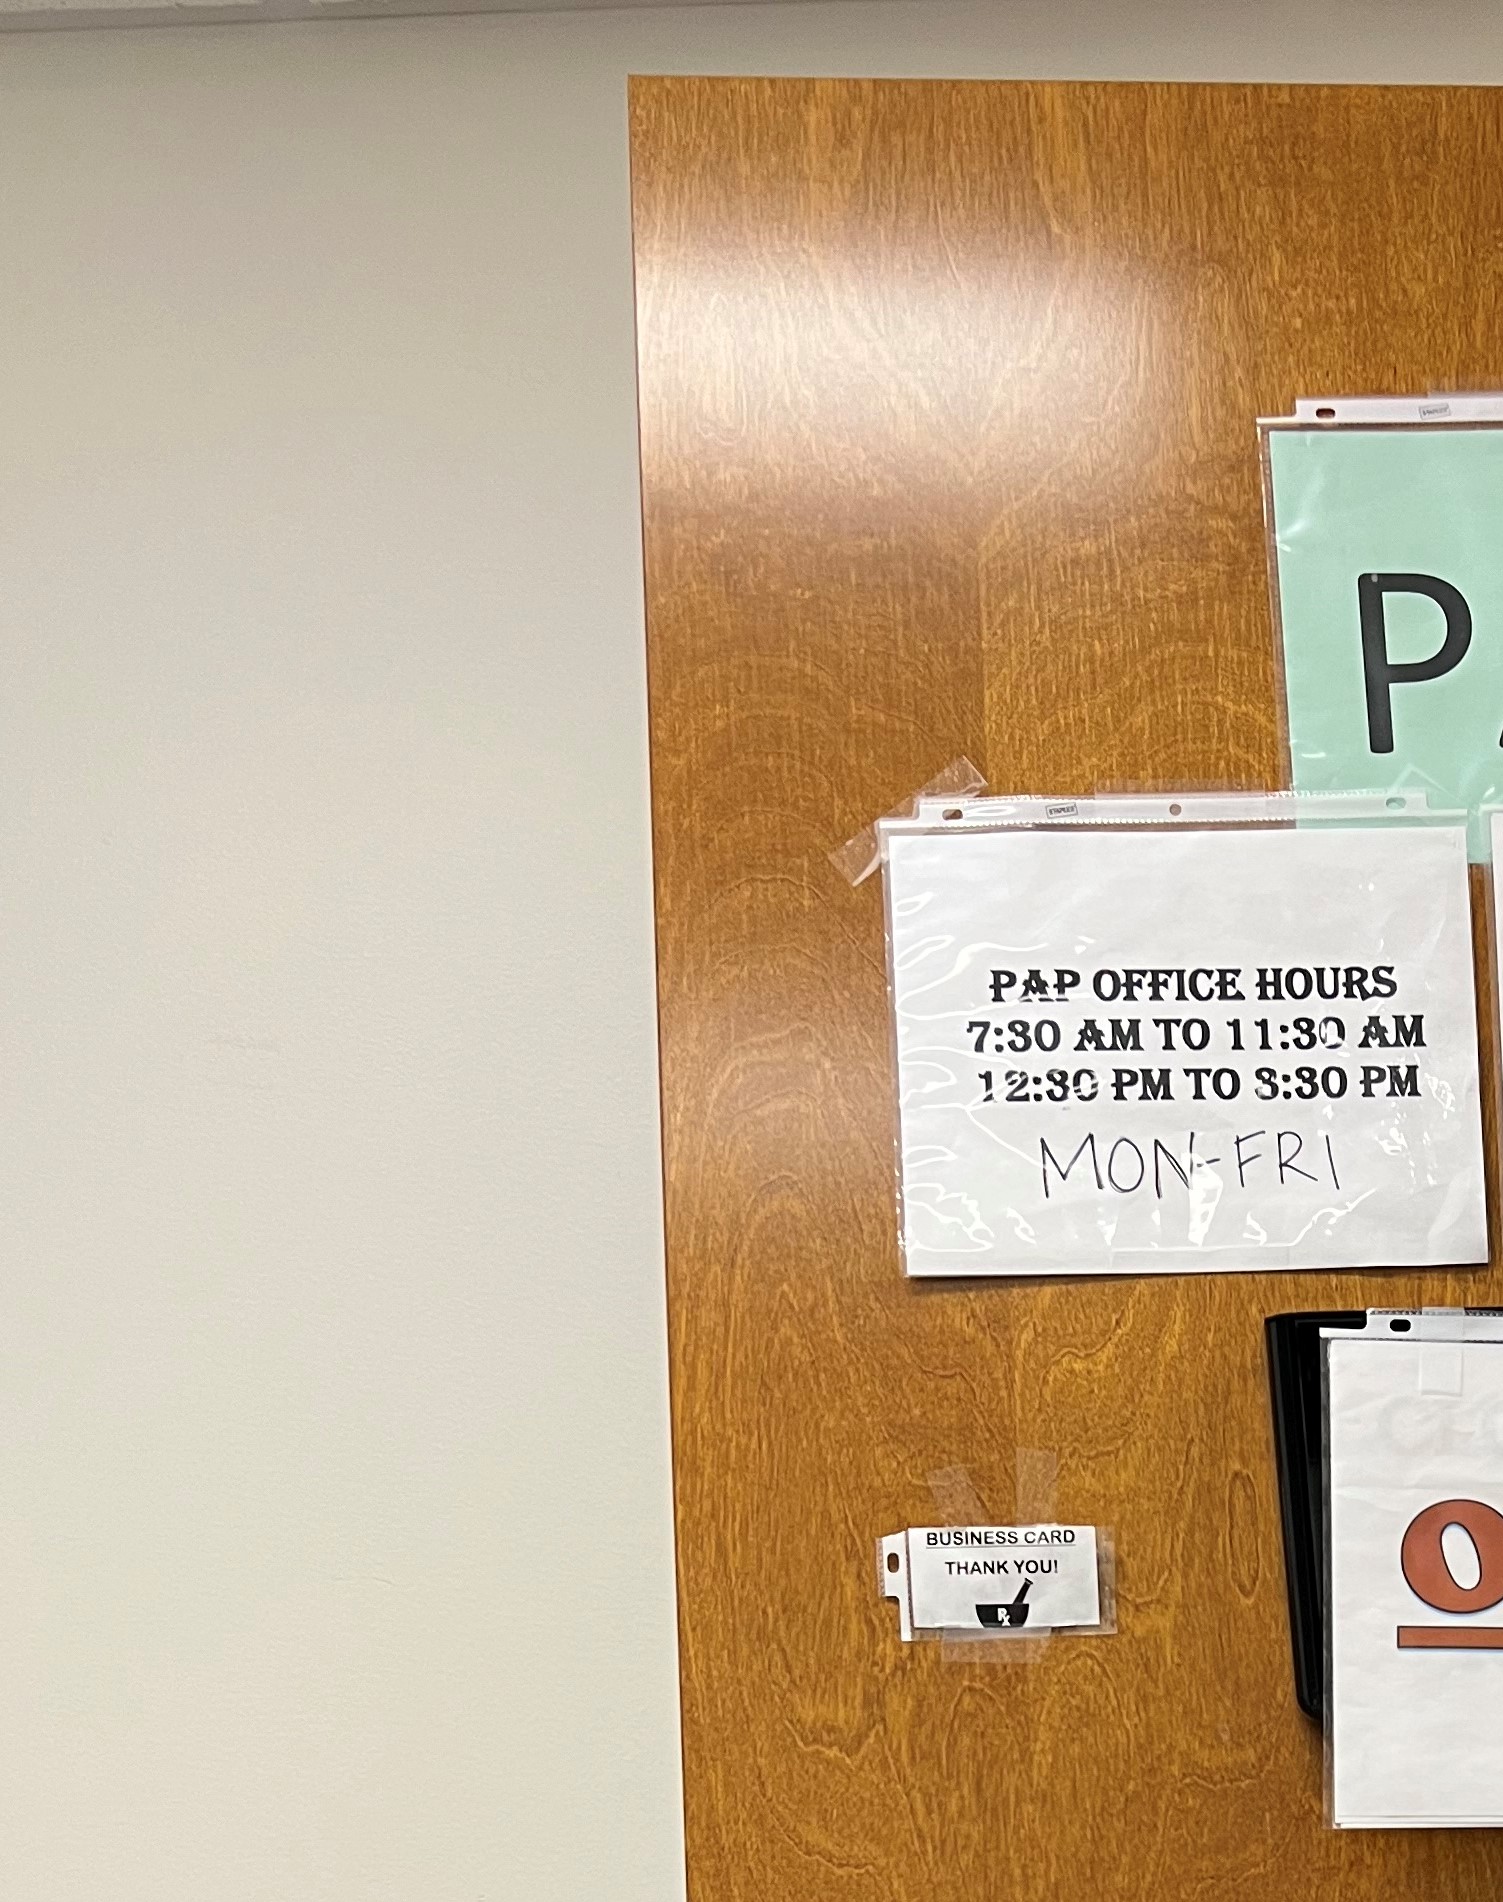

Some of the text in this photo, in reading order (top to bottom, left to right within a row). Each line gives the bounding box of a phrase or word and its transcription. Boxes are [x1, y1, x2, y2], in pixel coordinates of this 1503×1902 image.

[989, 966, 1397, 1002] PAP OFFICE HOURS
[967, 1015, 1426, 1052] 7:30 AM TO 11:30 AM
[979, 1065, 1421, 1102] 12:30 PM TO 3:30 PM
[1040, 1131, 1339, 1199] MON-FRI
[927, 1530, 1075, 1545] BUSINESS CARD
[945, 1560, 1057, 1574] THANK YOU!
